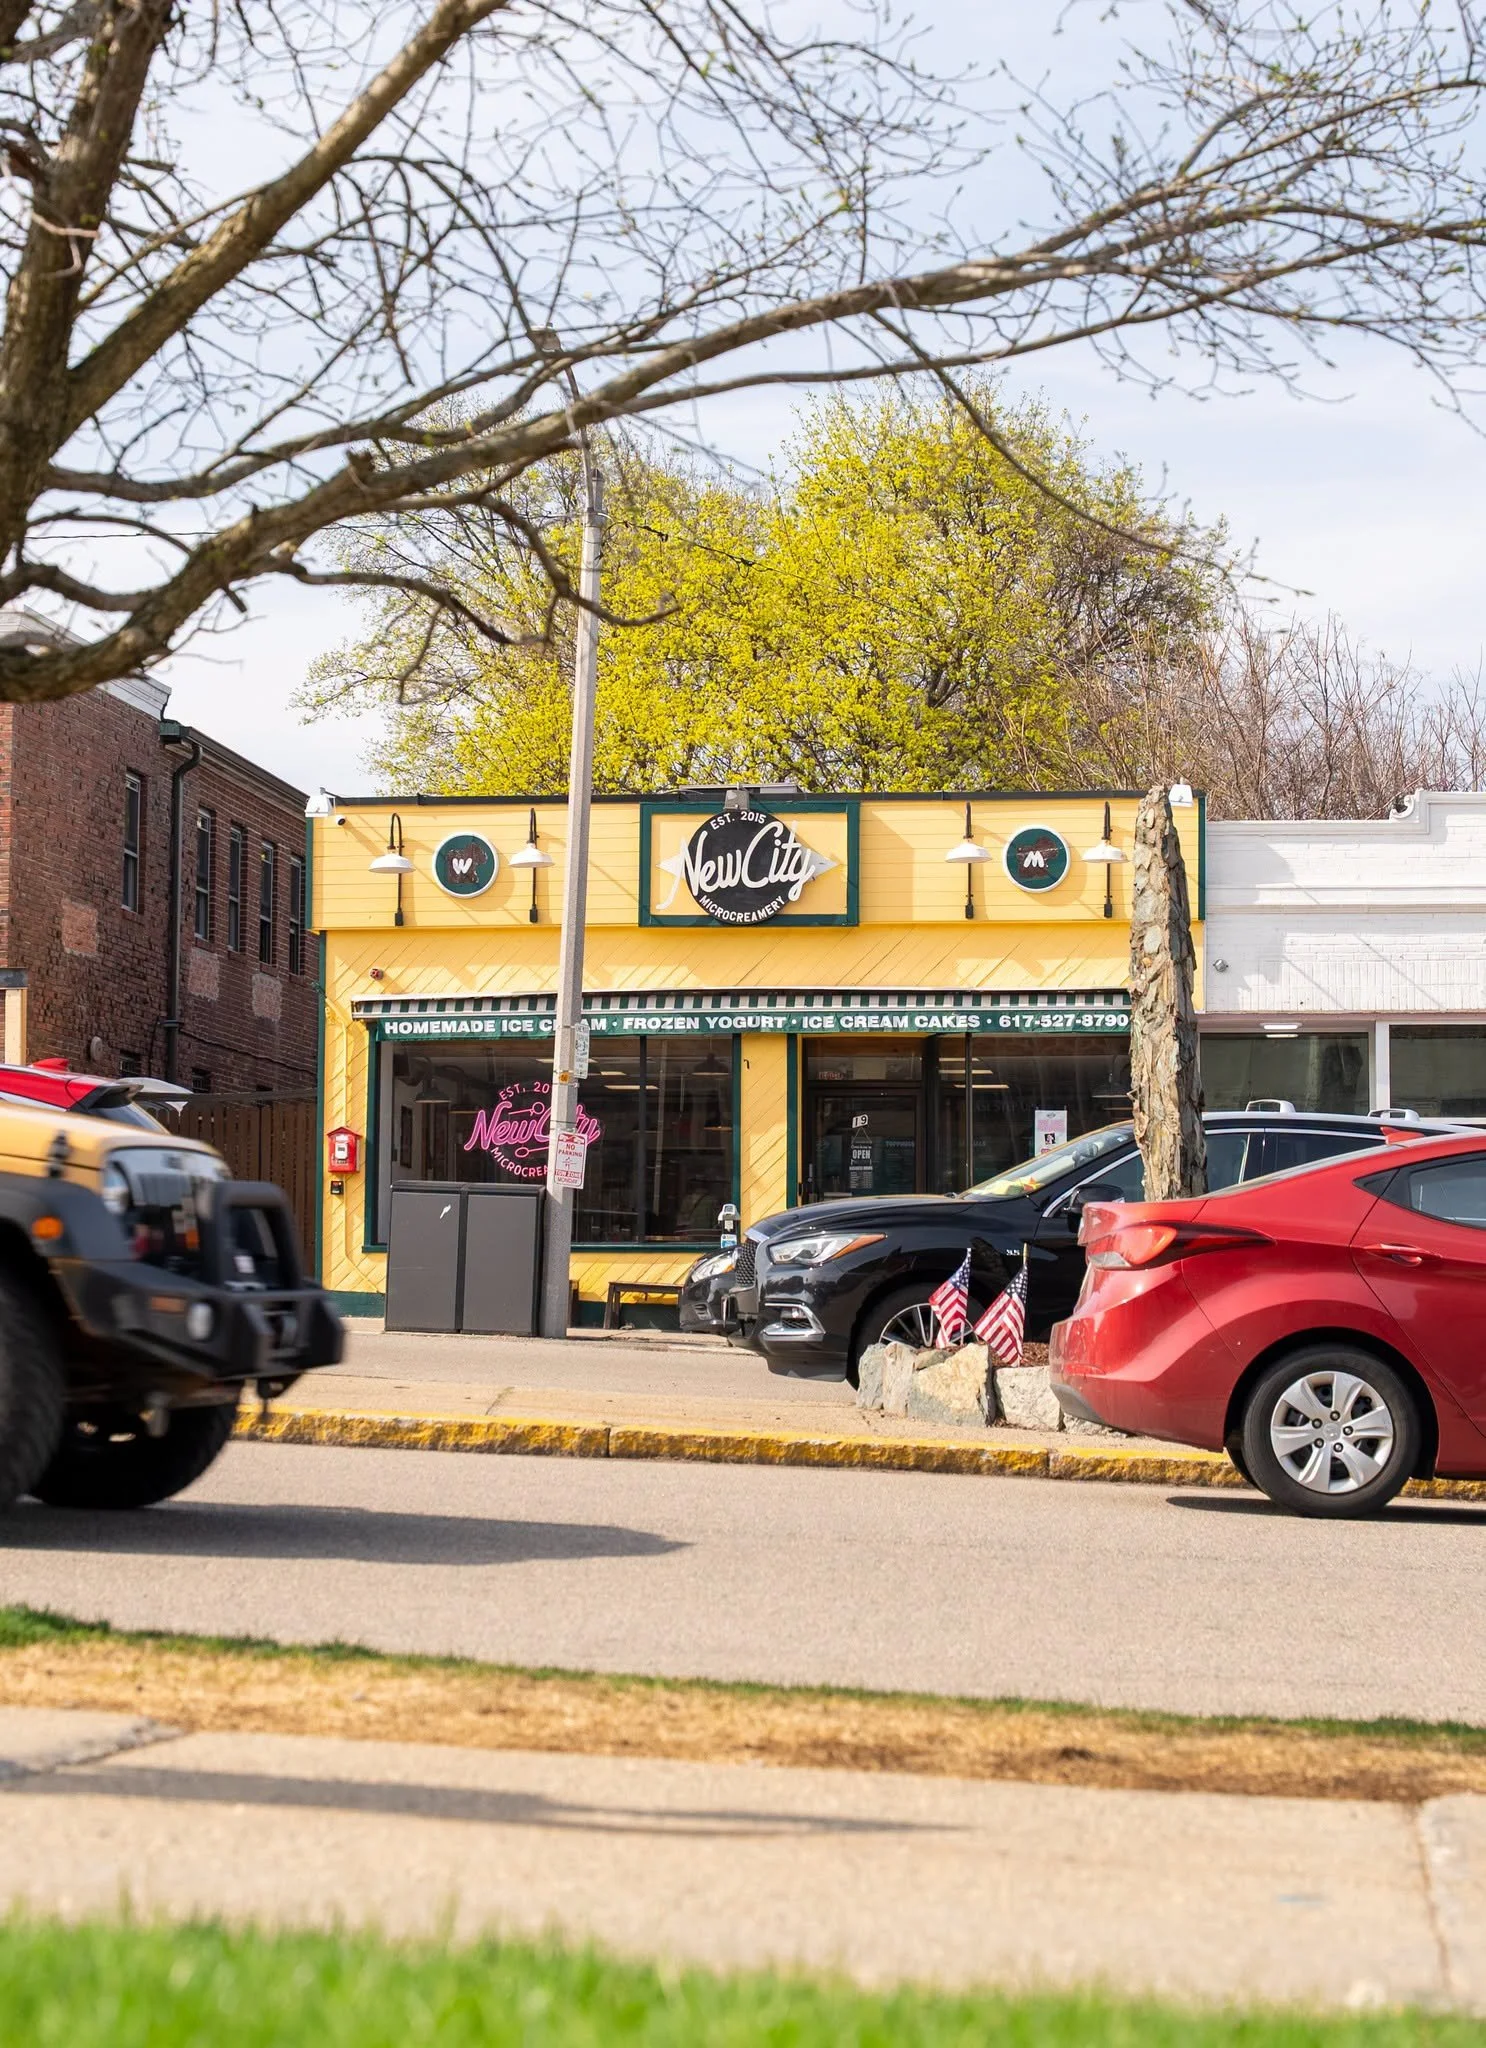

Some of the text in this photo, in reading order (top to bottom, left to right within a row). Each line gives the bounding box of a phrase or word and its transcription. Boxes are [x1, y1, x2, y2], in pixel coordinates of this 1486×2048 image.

[710, 811, 767, 830] EST. 2015
[452, 857, 473, 875] W
[656, 820, 816, 910] New City
[1023, 850, 1045, 868] M
[699, 894, 785, 923] MICROCREAMERY
[384, 1019, 496, 1034] HOMEMADE
[501, 1018, 534, 1033] ICE
[622, 1016, 700, 1030] FROZEN
[705, 1015, 787, 1029] YOGURT
[802, 1015, 834, 1029] ICE
[839, 1014, 909, 1028] CREAM
[914, 1013, 980, 1028] CAKES
[998, 1013, 1129, 1028] 617-527-8790
[499, 1081, 550, 1100] EST. 20
[464, 1101, 537, 1150] New
[854, 1114, 868, 1127] 19
[491, 1147, 549, 1178] MICROCREA
[852, 1149, 871, 1160] OPEN
